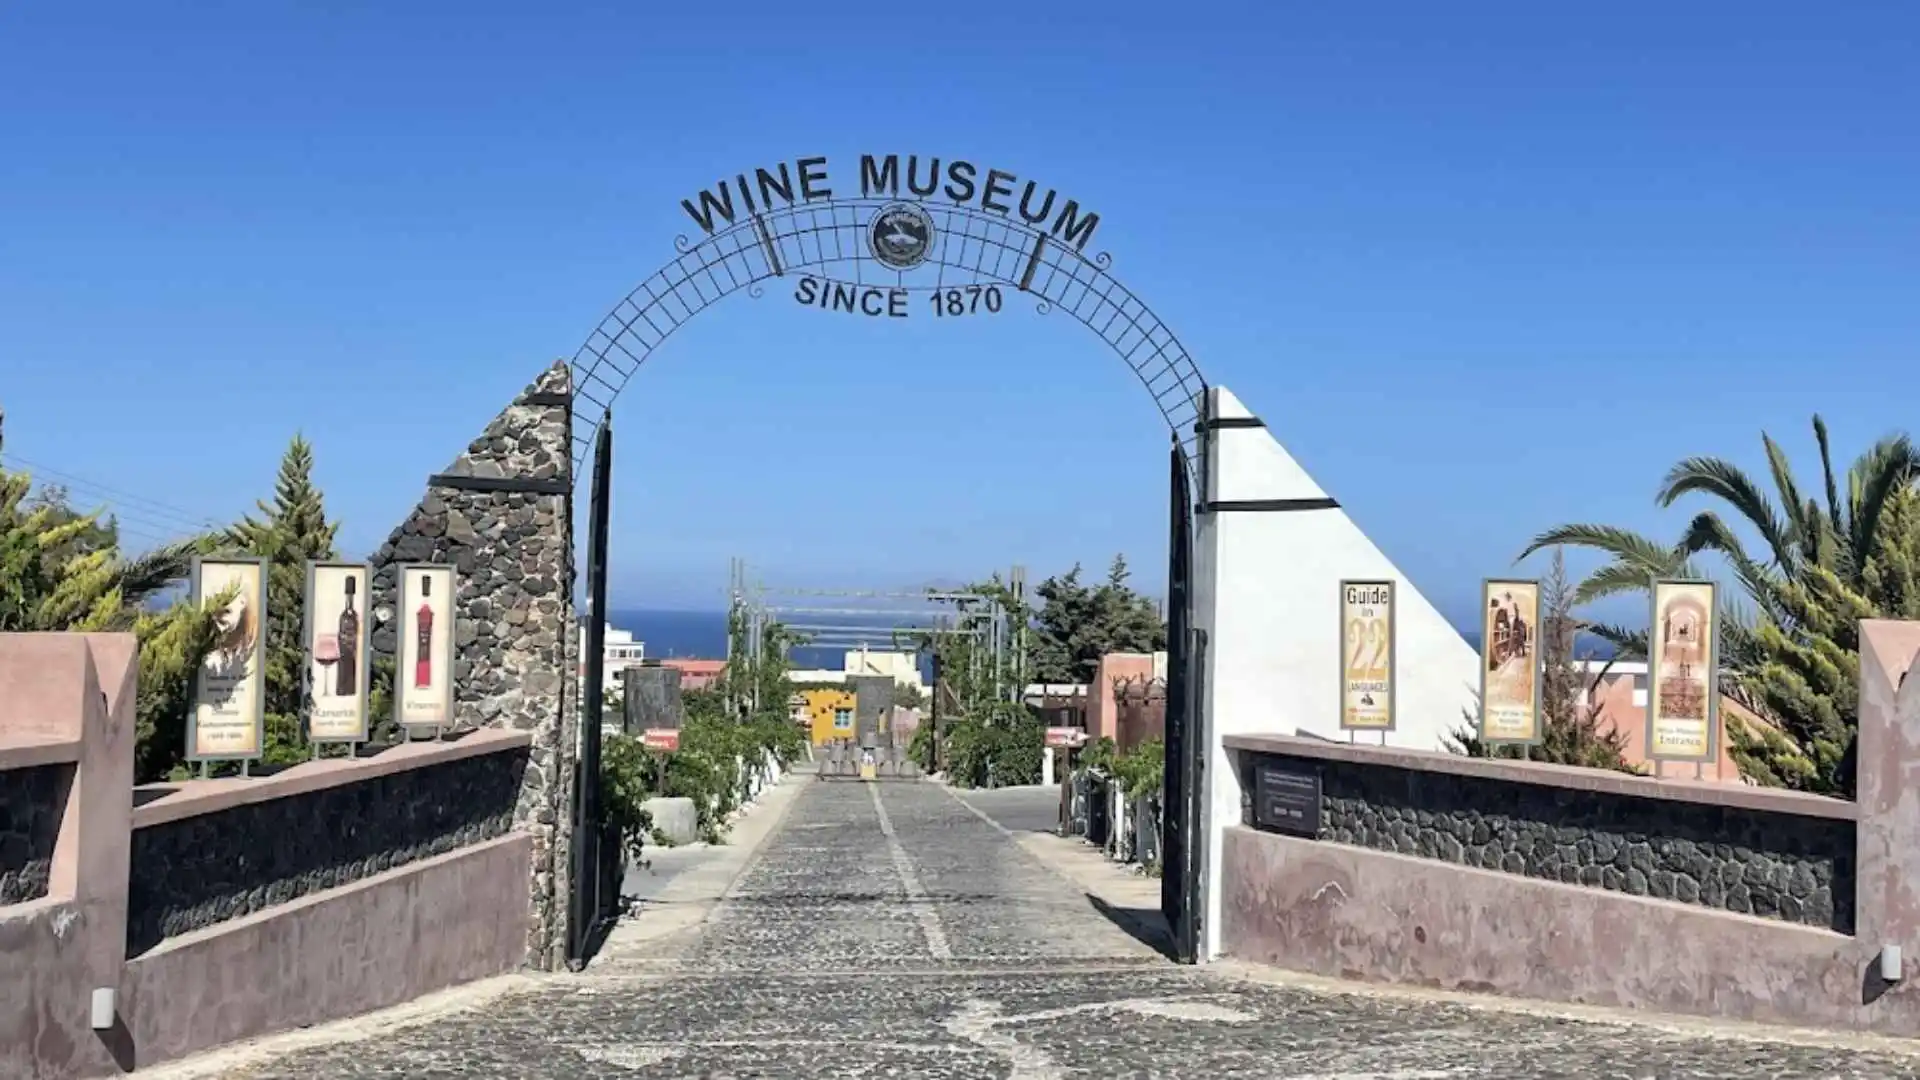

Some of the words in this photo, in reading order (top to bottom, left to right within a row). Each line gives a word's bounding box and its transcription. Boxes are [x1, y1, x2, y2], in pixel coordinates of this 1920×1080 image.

[680, 156, 832, 234] WINE
[860, 154, 1099, 252] MUSEUM
[794, 277, 909, 317] SINCE
[929, 287, 1003, 318] 1870
[1346, 586, 1388, 604] Guide
[1348, 617, 1388, 680] 22
